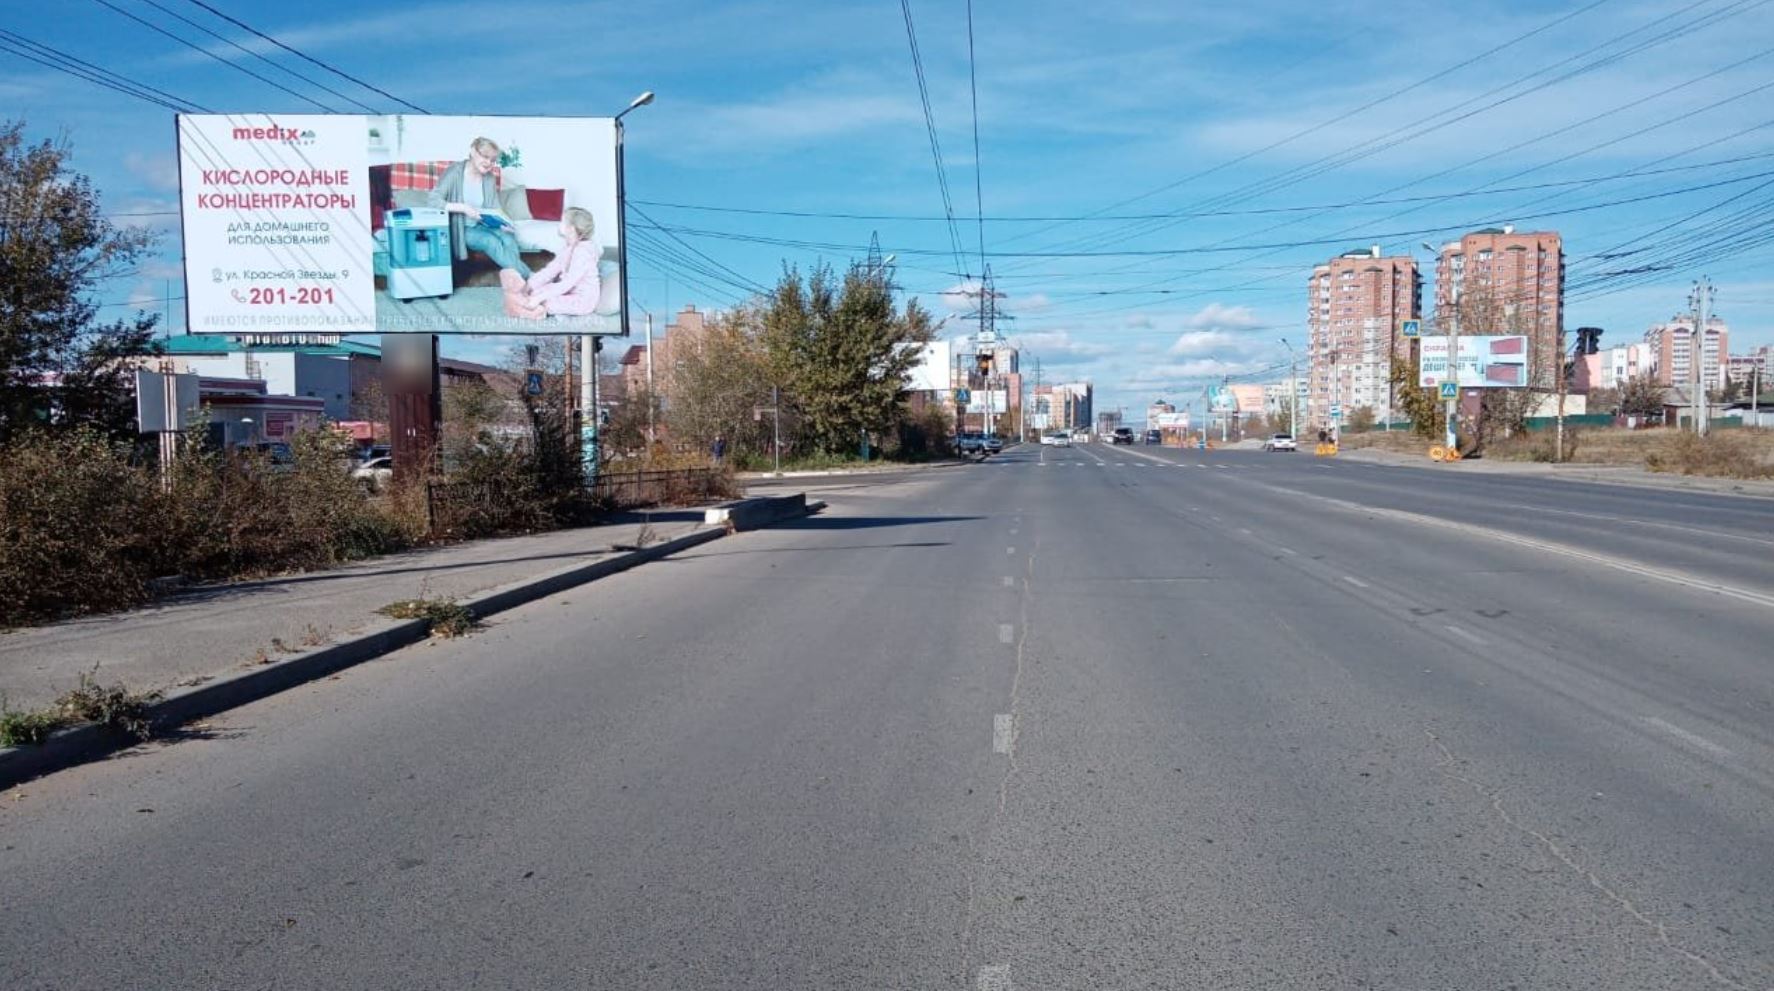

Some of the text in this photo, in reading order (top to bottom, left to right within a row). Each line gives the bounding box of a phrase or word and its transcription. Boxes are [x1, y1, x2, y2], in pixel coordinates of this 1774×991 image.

[233, 124, 299, 141] medix
[202, 170, 349, 187] КИСЛОРОДНЫЕ
[198, 193, 356, 211] КОНЦЕНТРАТОРЫ
[227, 222, 330, 232] ДЛЯ ДОМАШНЕГО
[228, 235, 331, 245] ИСПОЛЬЗОВАНИЯ
[243, 268, 295, 281] Красной
[341, 269, 350, 280] 9
[249, 287, 335, 305] 201-201
